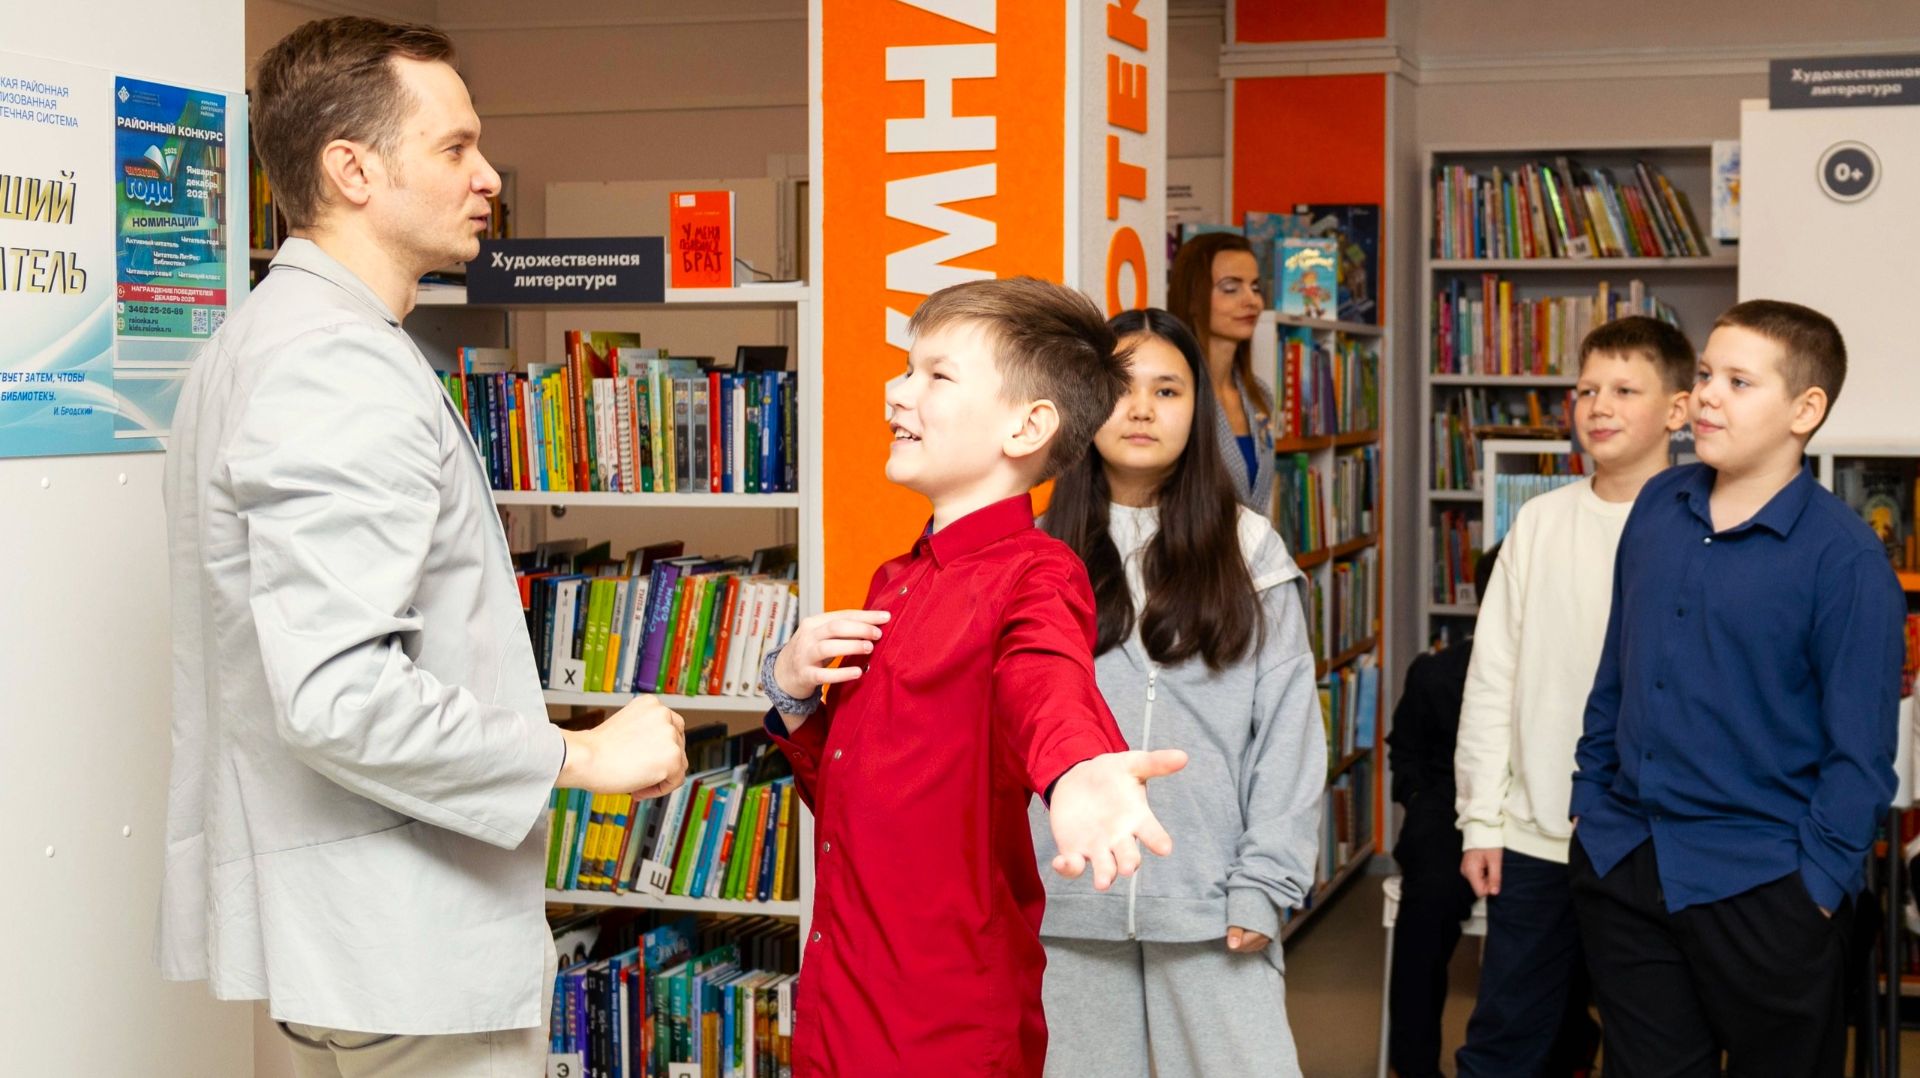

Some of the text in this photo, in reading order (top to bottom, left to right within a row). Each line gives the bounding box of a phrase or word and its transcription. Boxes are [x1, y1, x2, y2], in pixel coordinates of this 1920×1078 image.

[21, 80, 69, 98] РАЙОННАЯ
[1811, 84, 1902, 97] литература
[37, 111, 79, 128] СИСТЕМА
[117, 116, 223, 142] РАЙОННЫЙ КОНКУРС
[1834, 162, 1864, 182] 0+
[186, 179, 218, 191] декабрь
[187, 190, 209, 200] 2025
[132, 217, 200, 229] НОМИНАЦИИ
[681, 222, 721, 241] У МЕНЯ
[491, 251, 640, 270] Художественная
[682, 251, 723, 274] БРАТ
[514, 273, 617, 289] литература
[131, 286, 214, 297] НАГРАЖДЕНИЕ ПОБЕДИТЕЛЕЙ
[25, 372, 55, 384] ЗАТЕМ,
[57, 372, 86, 383] ЧТОБЫ
[1, 391, 57, 401] БИБЛИОТЕКУ.
[564, 669, 577, 685] Х
[650, 870, 668, 892] Ш
[557, 1063, 570, 1078] Э
